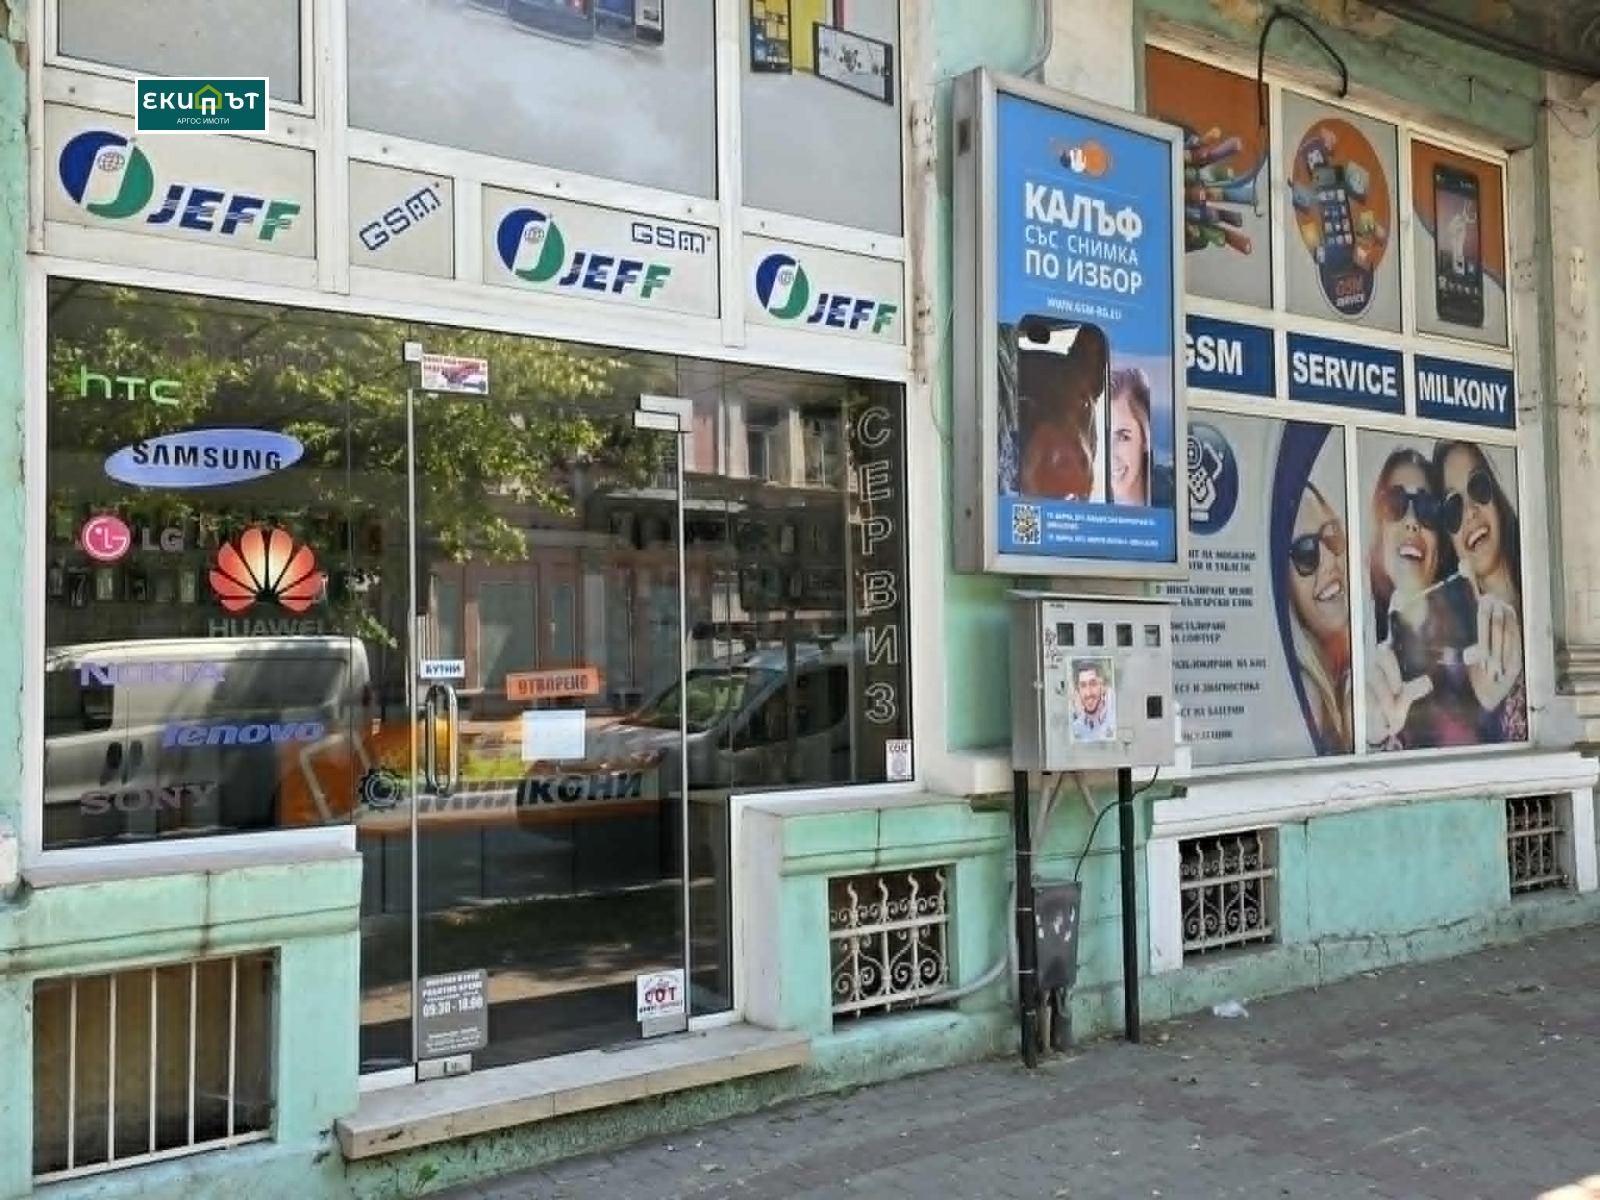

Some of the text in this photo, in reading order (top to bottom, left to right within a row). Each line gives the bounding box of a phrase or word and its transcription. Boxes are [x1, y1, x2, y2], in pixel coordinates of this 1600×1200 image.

[147, 184, 301, 241] JEFF
[359, 186, 442, 251] GSM
[1025, 182, 1143, 244] КАЛЪФ
[631, 222, 707, 254] GSM
[1025, 224, 1139, 267] СЪС СНИМКА
[559, 250, 672, 299] JEFF
[1025, 249, 1143, 295] ПО ИЗБОР
[807, 293, 899, 335] JEFF
[1293, 351, 1398, 398] SERVICE
[1418, 371, 1509, 413] MILKONY
[132, 443, 282, 471] SAMSUNG
[141, 527, 185, 551] LG
[208, 619, 326, 638] HUAWEI
[80, 781, 218, 815] SONY
